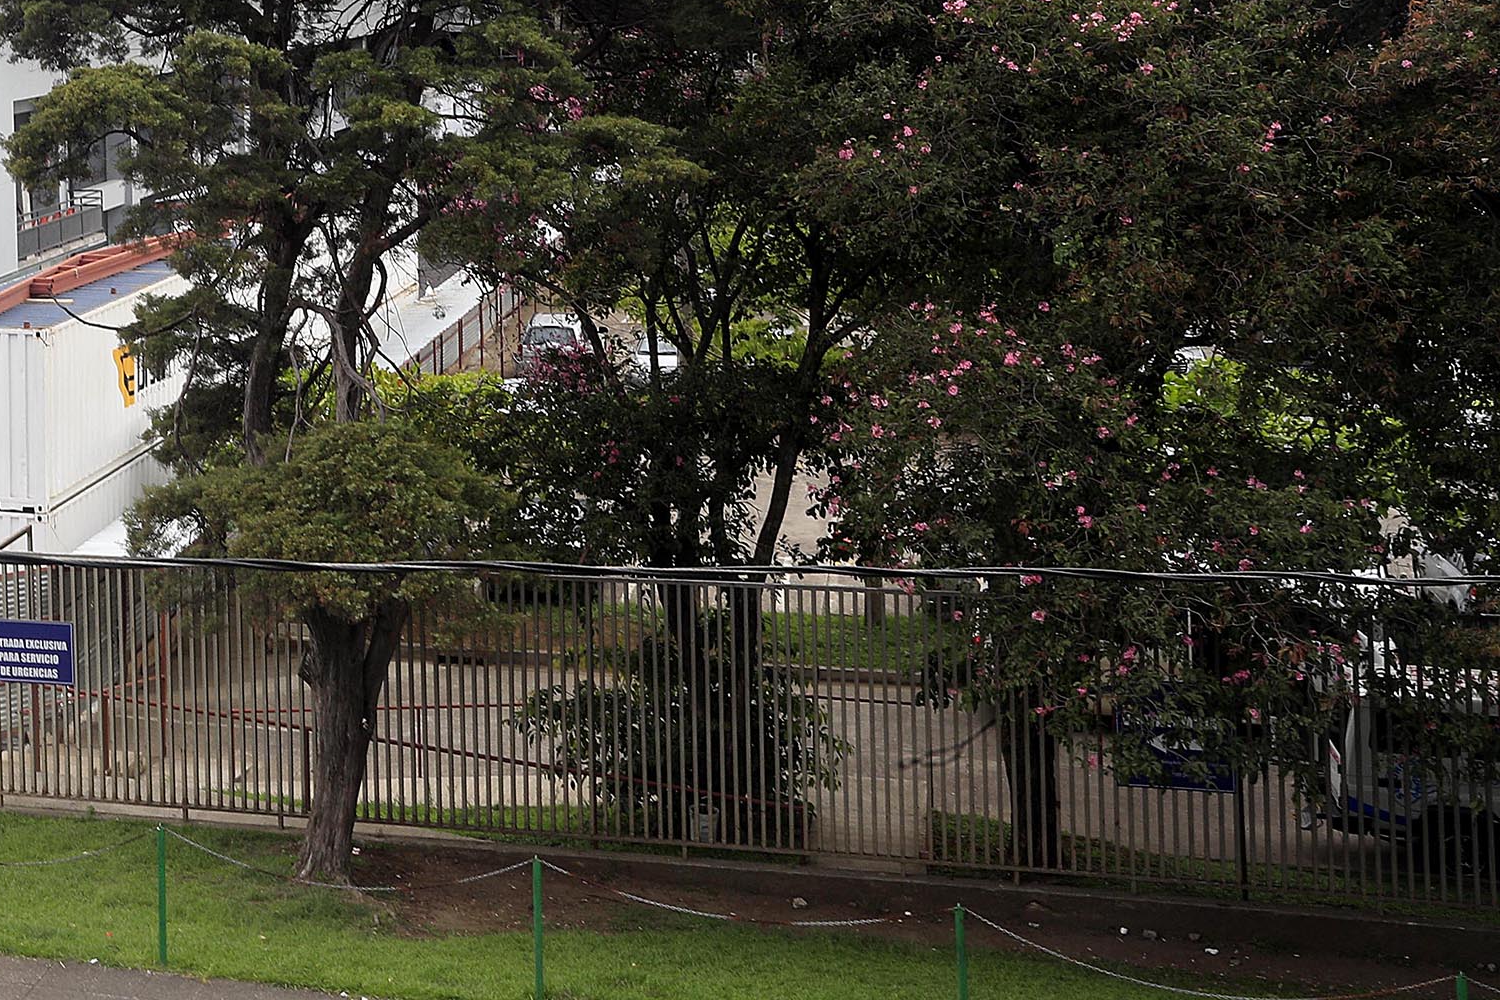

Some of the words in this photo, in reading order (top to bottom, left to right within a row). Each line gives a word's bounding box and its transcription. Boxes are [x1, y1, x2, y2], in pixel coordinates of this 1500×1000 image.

[25, 639, 68, 651] EXCLUSIVA
[20, 652, 59, 665] SERVICIO
[0, 665, 11, 677] DE
[11, 666, 59, 679] URGENCIAS
